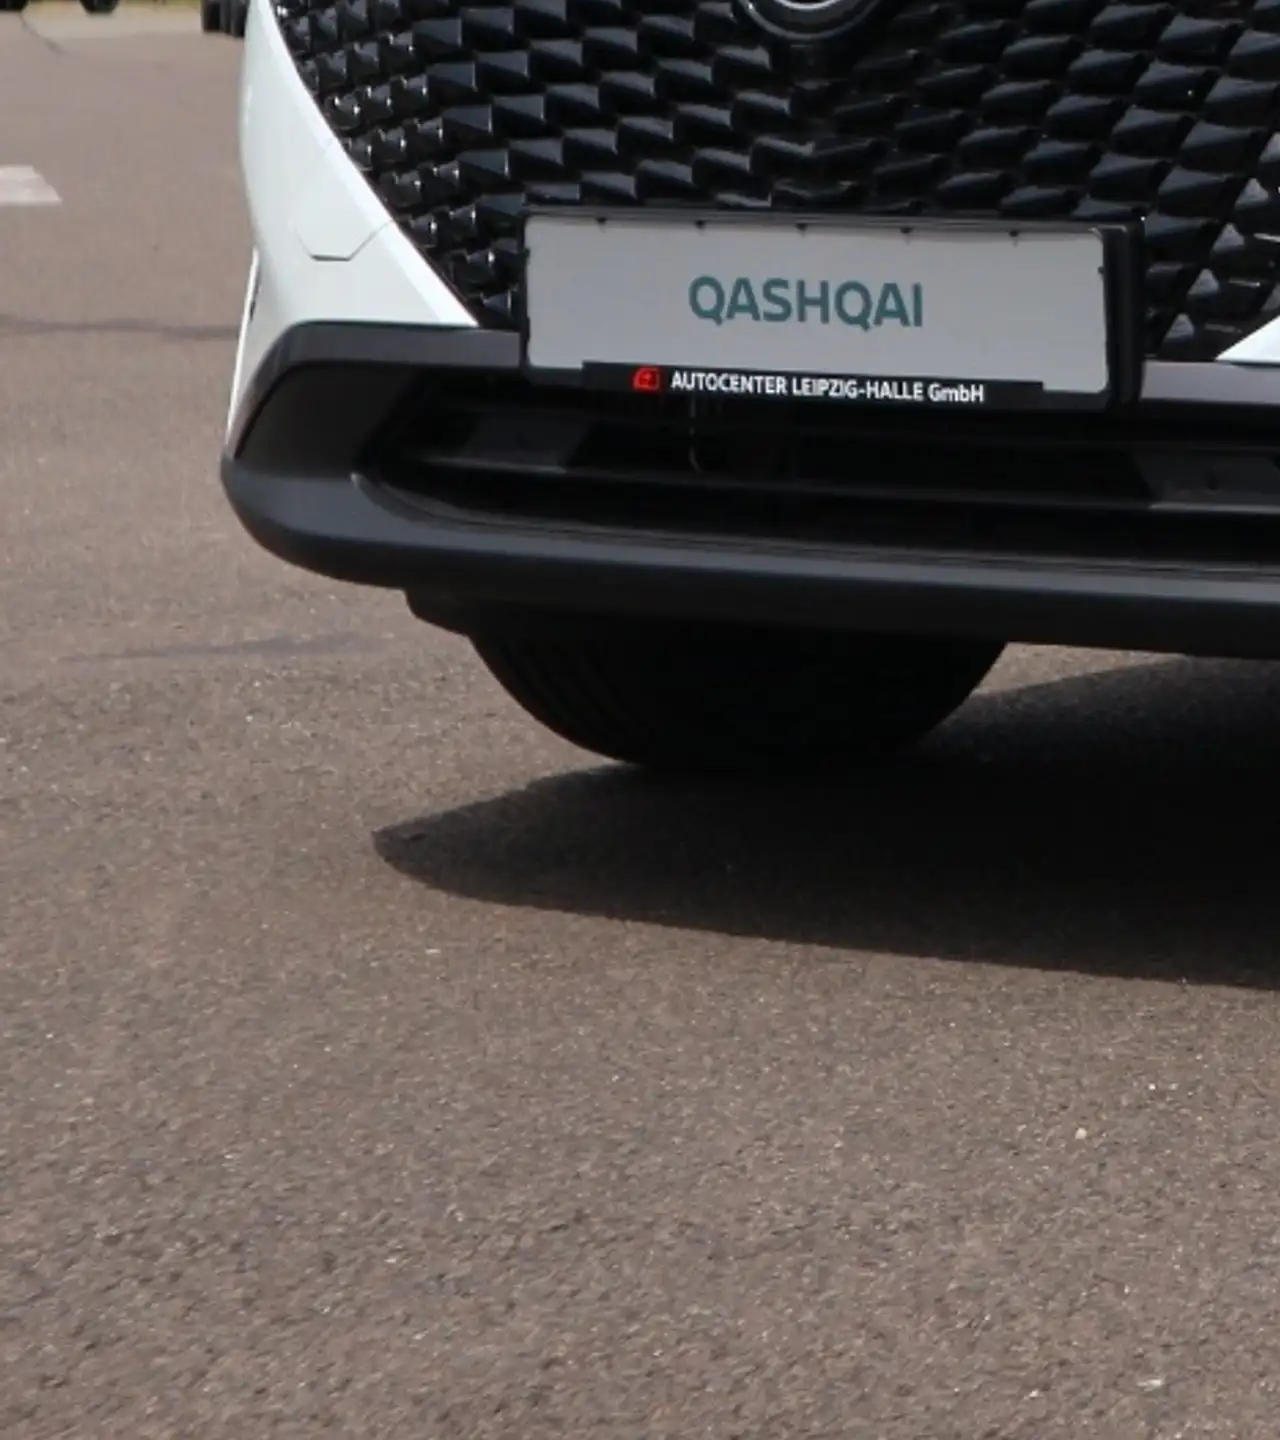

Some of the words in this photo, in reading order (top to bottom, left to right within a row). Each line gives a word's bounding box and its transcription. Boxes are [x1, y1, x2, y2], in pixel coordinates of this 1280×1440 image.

[687, 275, 924, 332] QASHQAI
[670, 369, 788, 396] AUTOCENTER
[791, 375, 924, 402] LEIPZIG-HALLE
[928, 382, 985, 405] GmbH
